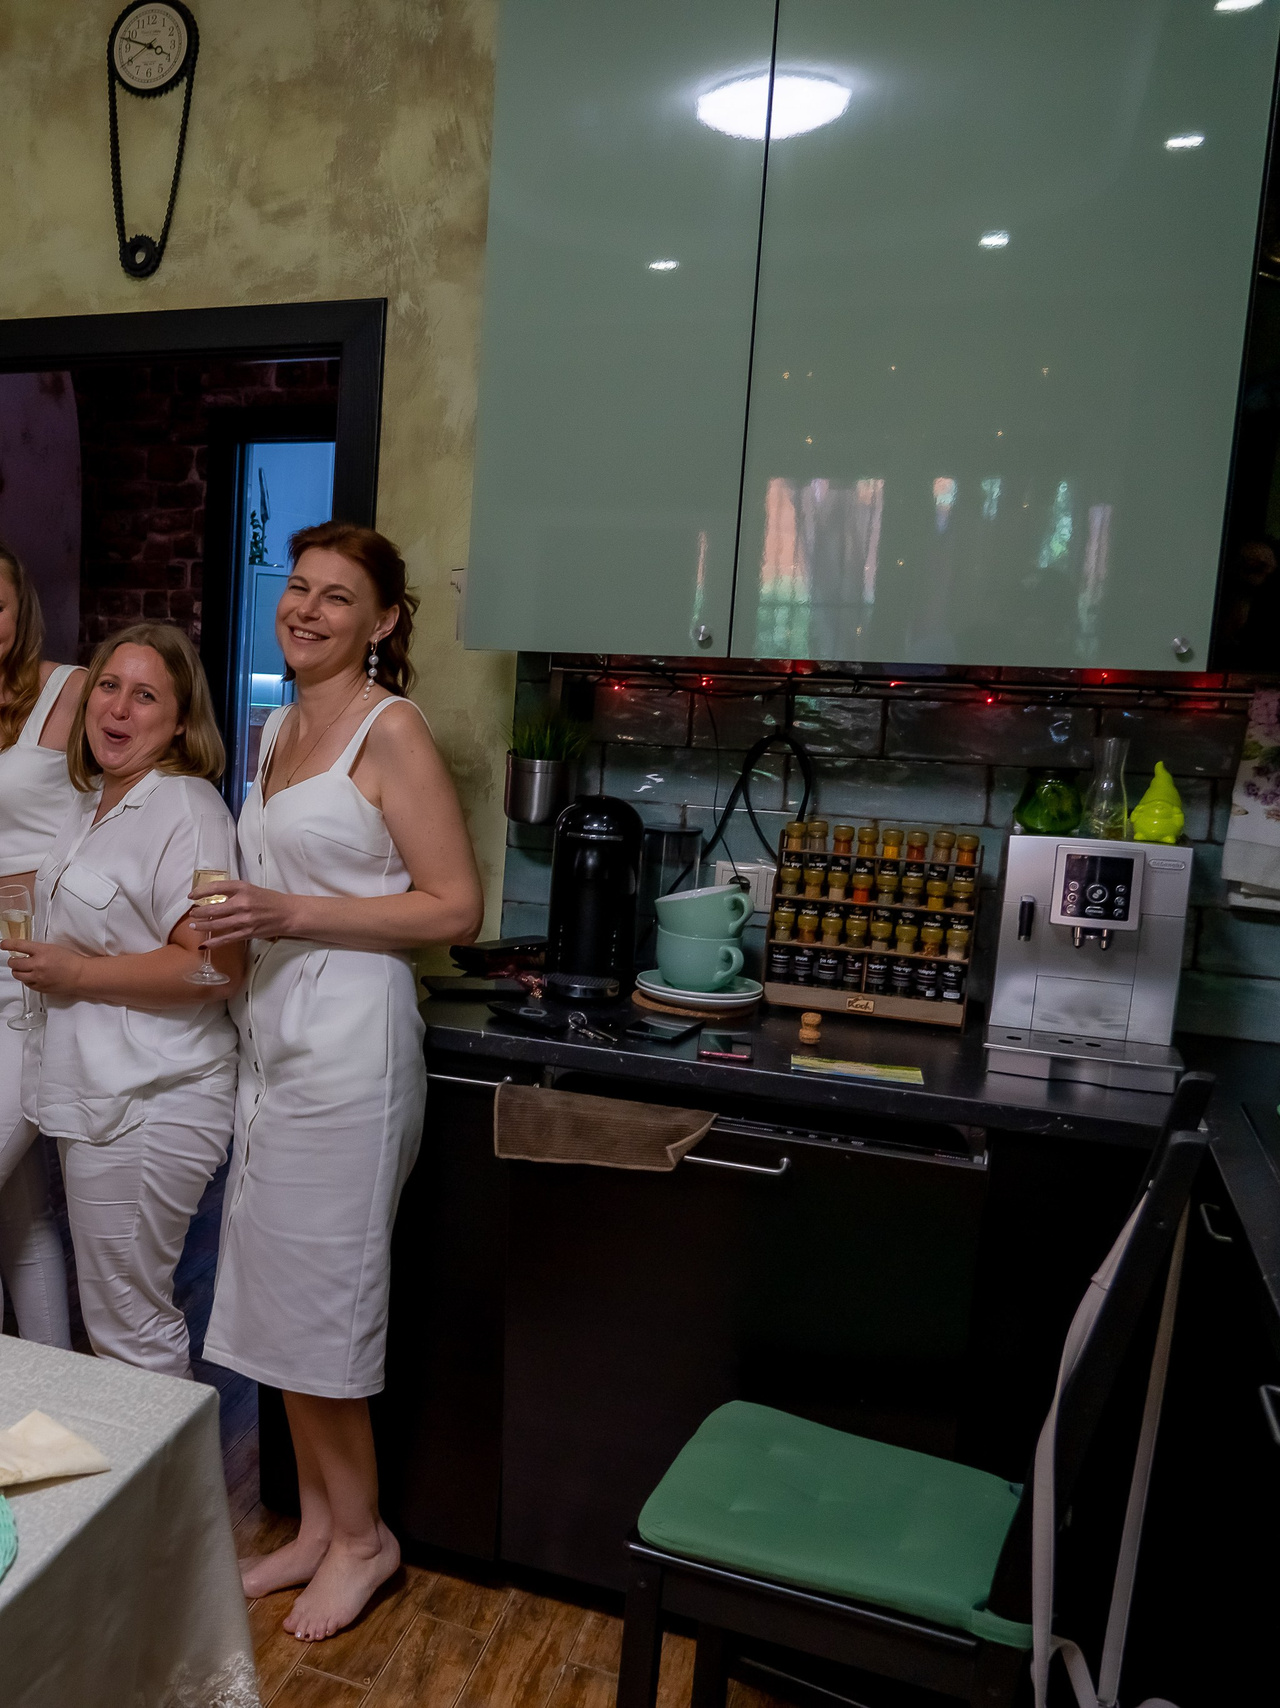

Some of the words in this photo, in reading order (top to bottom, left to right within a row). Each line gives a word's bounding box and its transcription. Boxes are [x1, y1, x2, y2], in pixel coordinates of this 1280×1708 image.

[137, 19, 145, 29] 11
[147, 14, 158, 25] 12
[161, 18, 167, 27] 1
[168, 26, 175, 37] 2
[124, 43, 131, 53] 9
[170, 40, 176, 49] 3
[135, 65, 141, 75] 7
[145, 68, 152, 78] 6
[157, 64, 164, 73] 5
